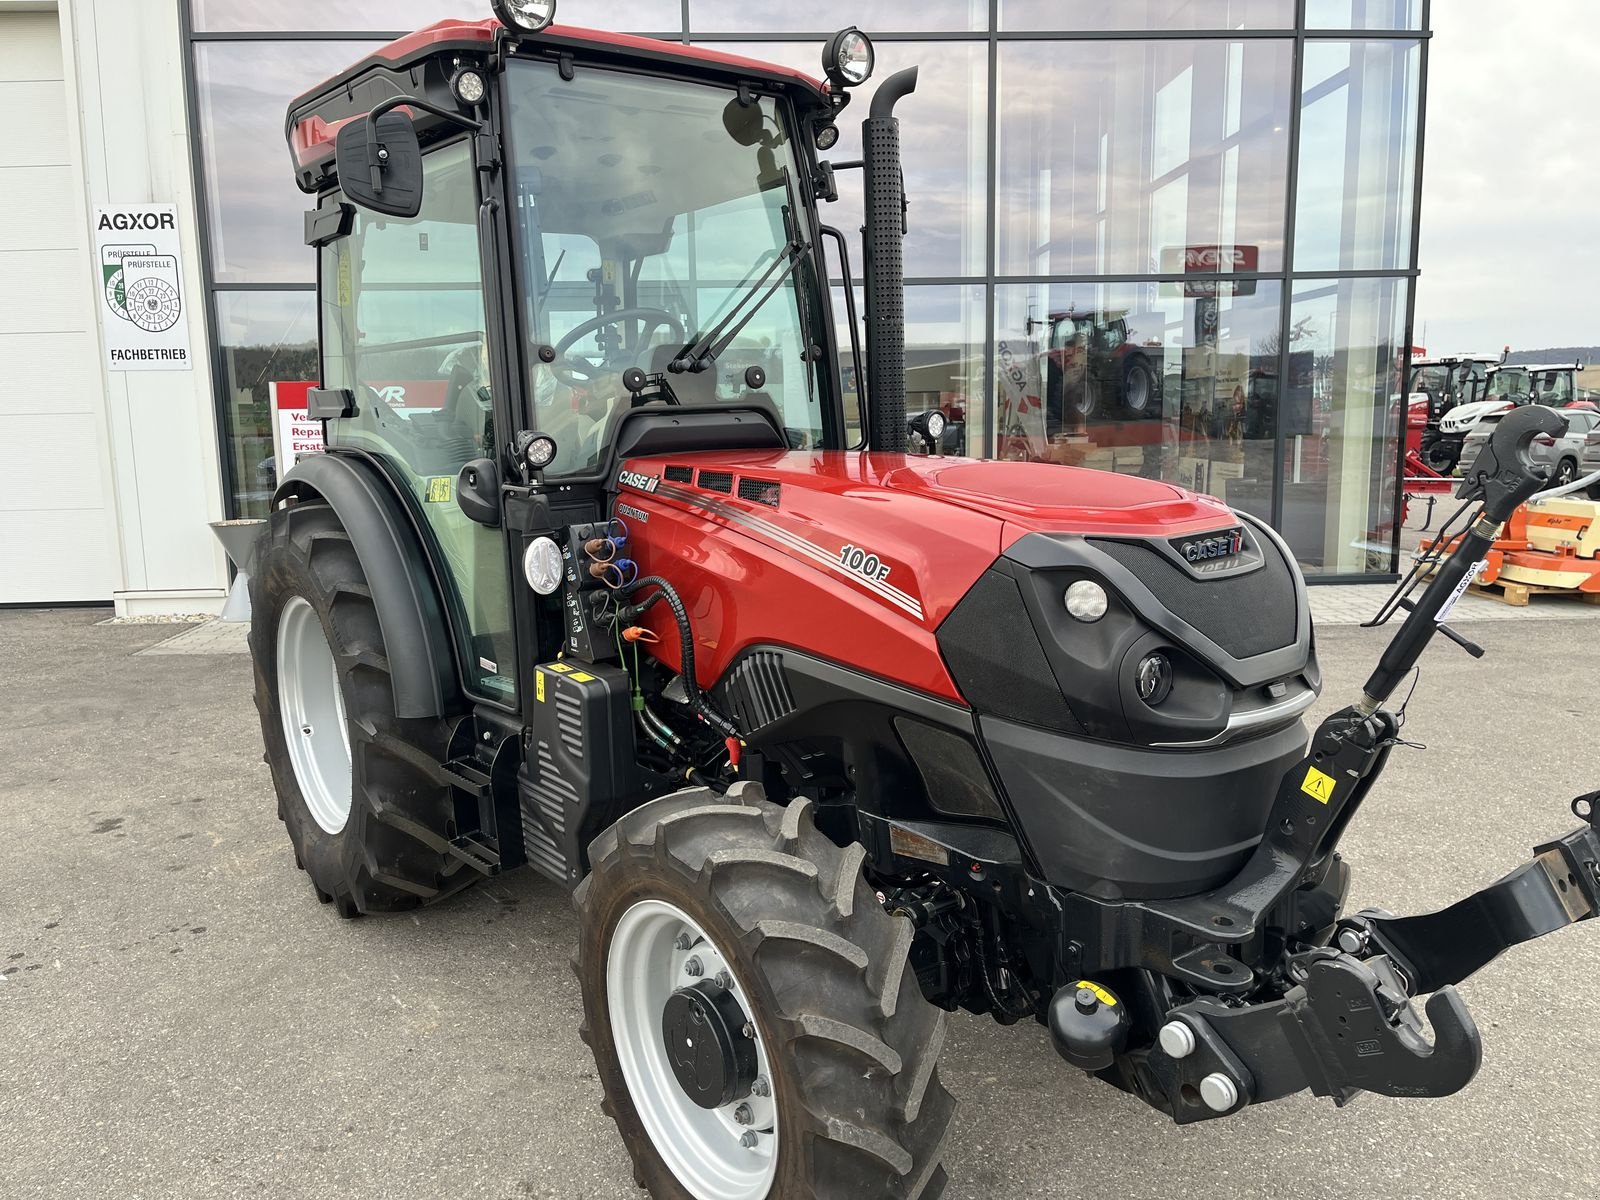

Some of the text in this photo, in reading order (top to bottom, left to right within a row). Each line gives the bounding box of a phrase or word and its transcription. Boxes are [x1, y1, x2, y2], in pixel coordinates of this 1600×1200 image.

[98, 213, 175, 230] AGXOR
[127, 260, 172, 268] PRÜFSTELLE
[111, 349, 187, 360] FACHBETRIEB
[291, 413, 309, 421] Ve
[292, 427, 323, 438] Repa
[618, 470, 648, 489] CASE
[618, 503, 649, 523] QUANTUM
[1182, 537, 1228, 561] CASE
